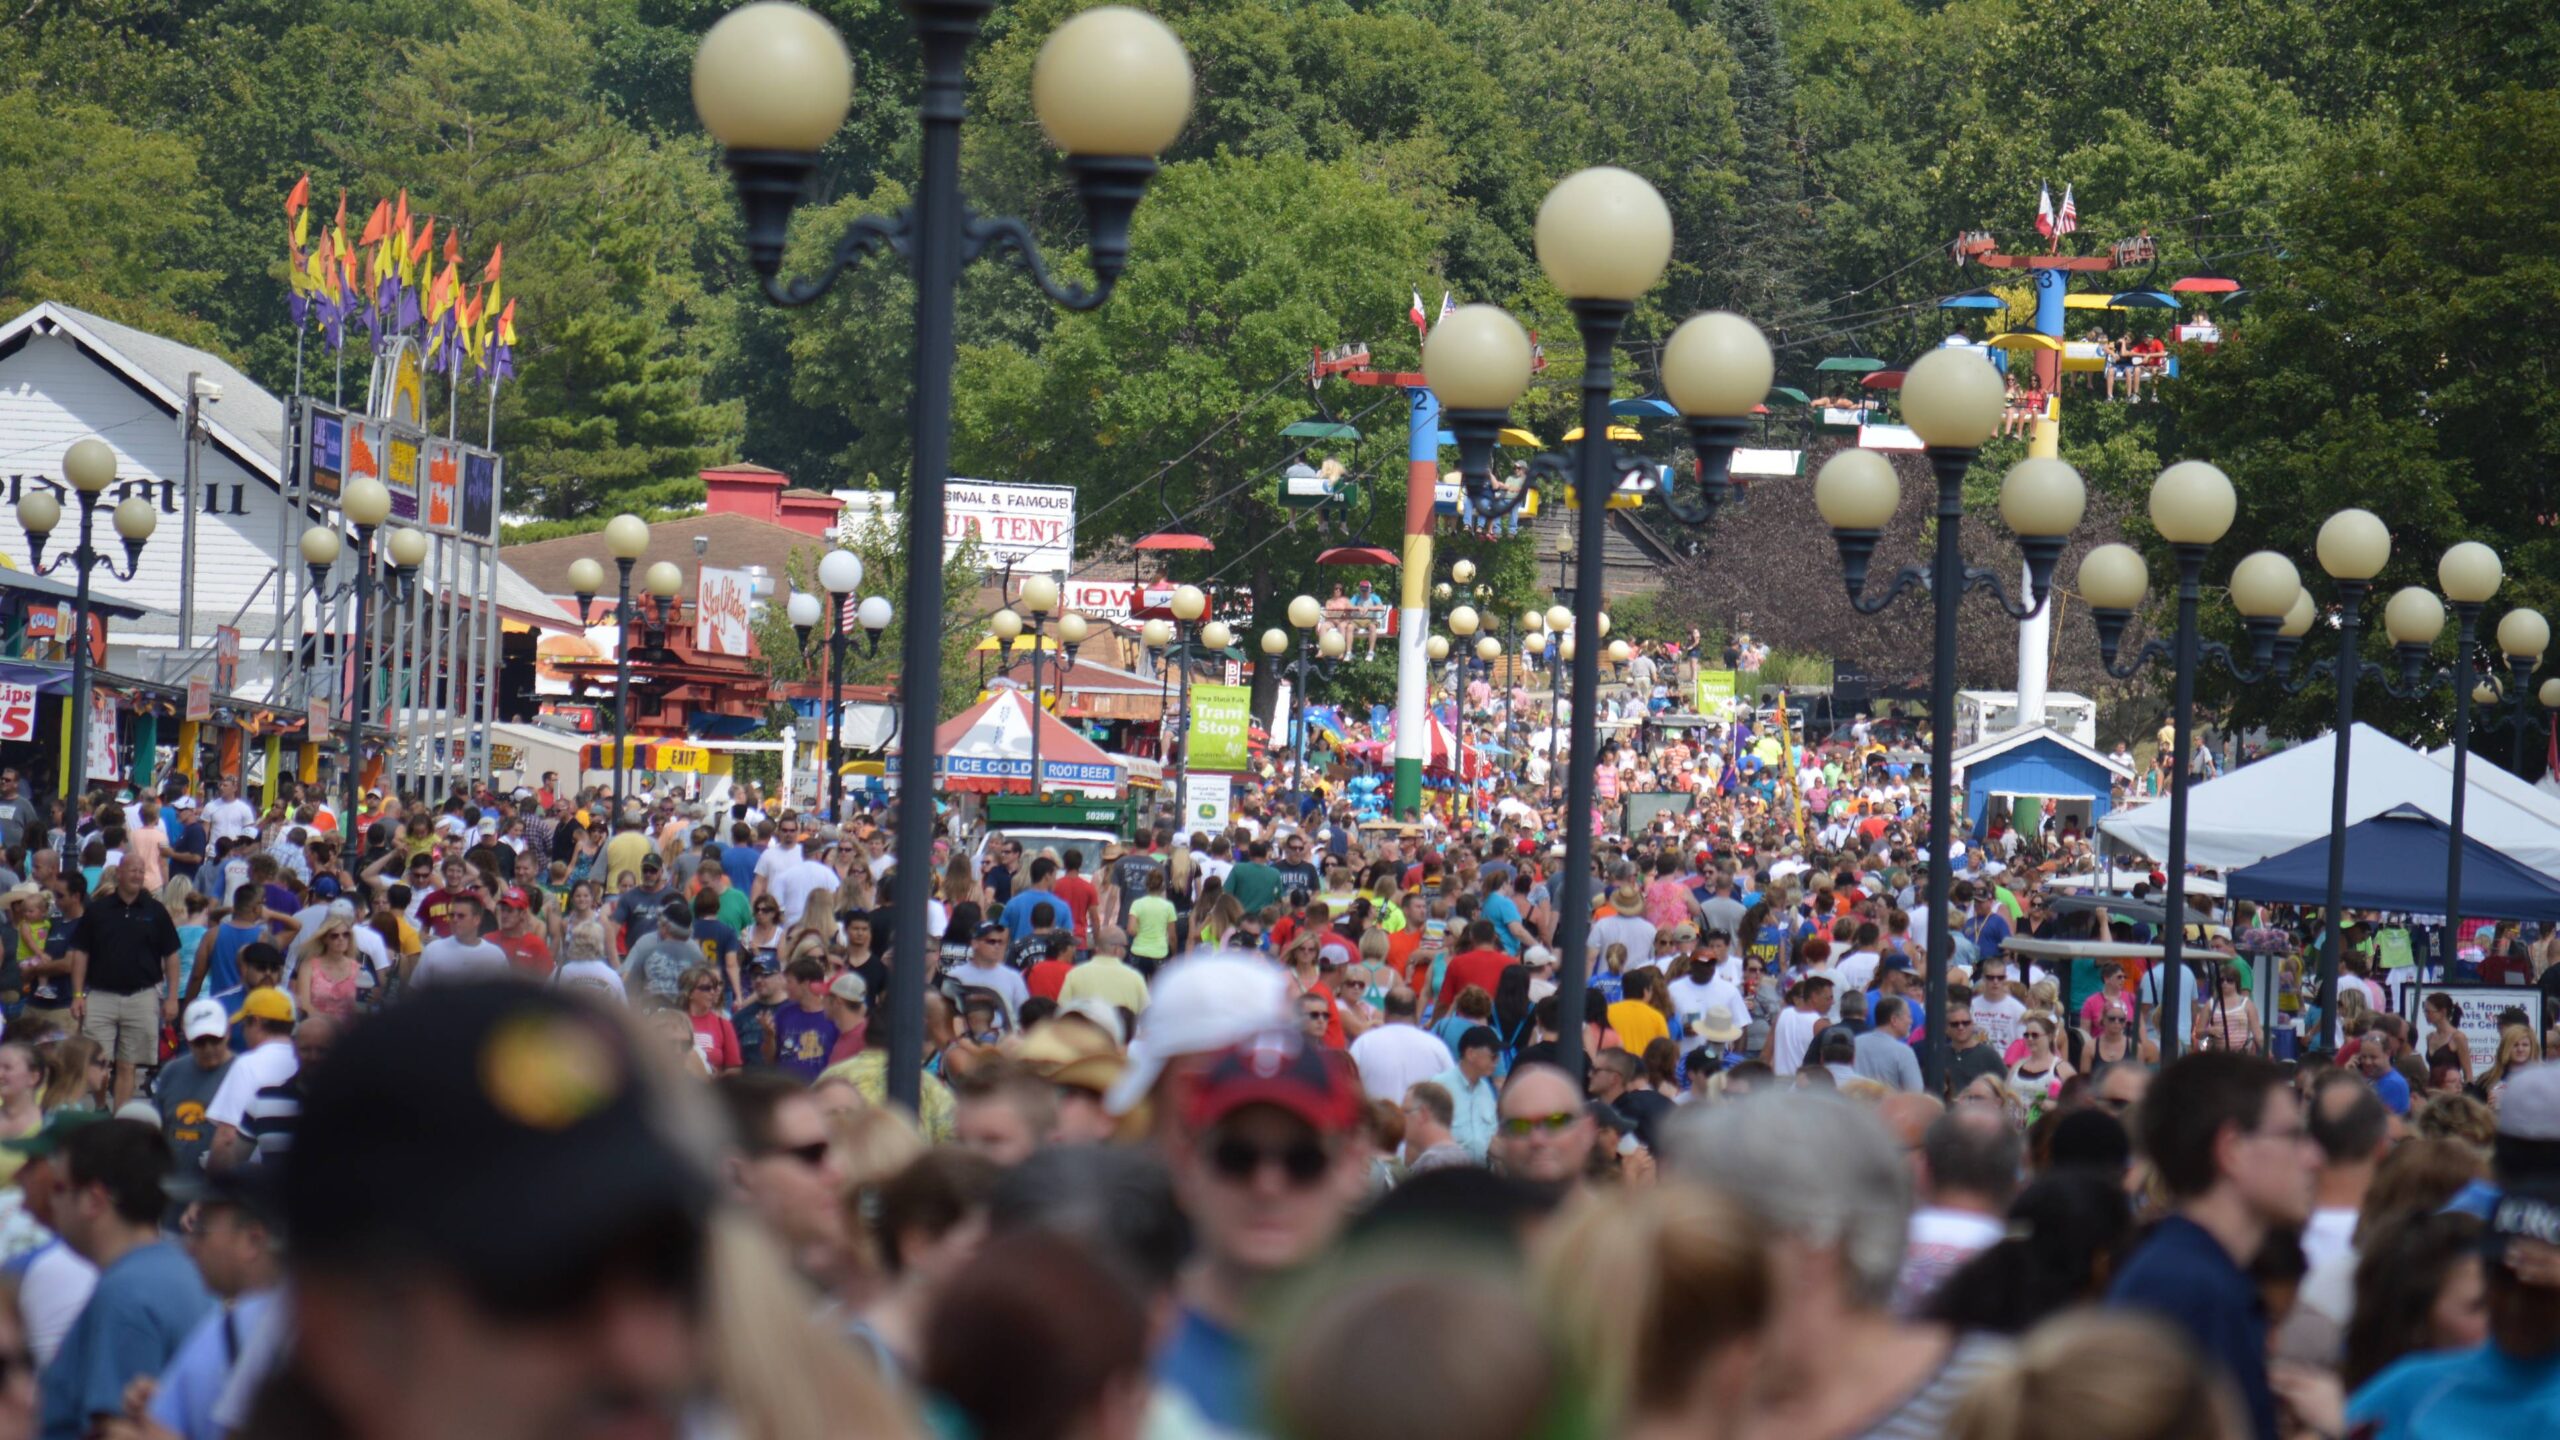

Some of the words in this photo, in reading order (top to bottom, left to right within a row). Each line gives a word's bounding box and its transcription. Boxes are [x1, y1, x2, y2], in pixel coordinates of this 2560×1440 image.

[2040, 271, 2052, 289] 3
[1414, 391, 1428, 411] 2
[944, 490, 985, 504] GINAL
[992, 493, 1001, 505] &
[1007, 494, 1068, 510] FAMOUS
[944, 514, 981, 539] UD
[991, 516, 1063, 543] TENT
[1076, 588, 1132, 606] IOW
[30, 612, 56, 630] COLD
[1196, 704, 1243, 720] Tram
[1198, 721, 1240, 739] Stop
[671, 750, 697, 767] EXIT
[955, 759, 982, 772] ICE
[986, 760, 1032, 774] COLD
[1048, 764, 1078, 777] ROOT
[1081, 766, 1110, 779] BEER
